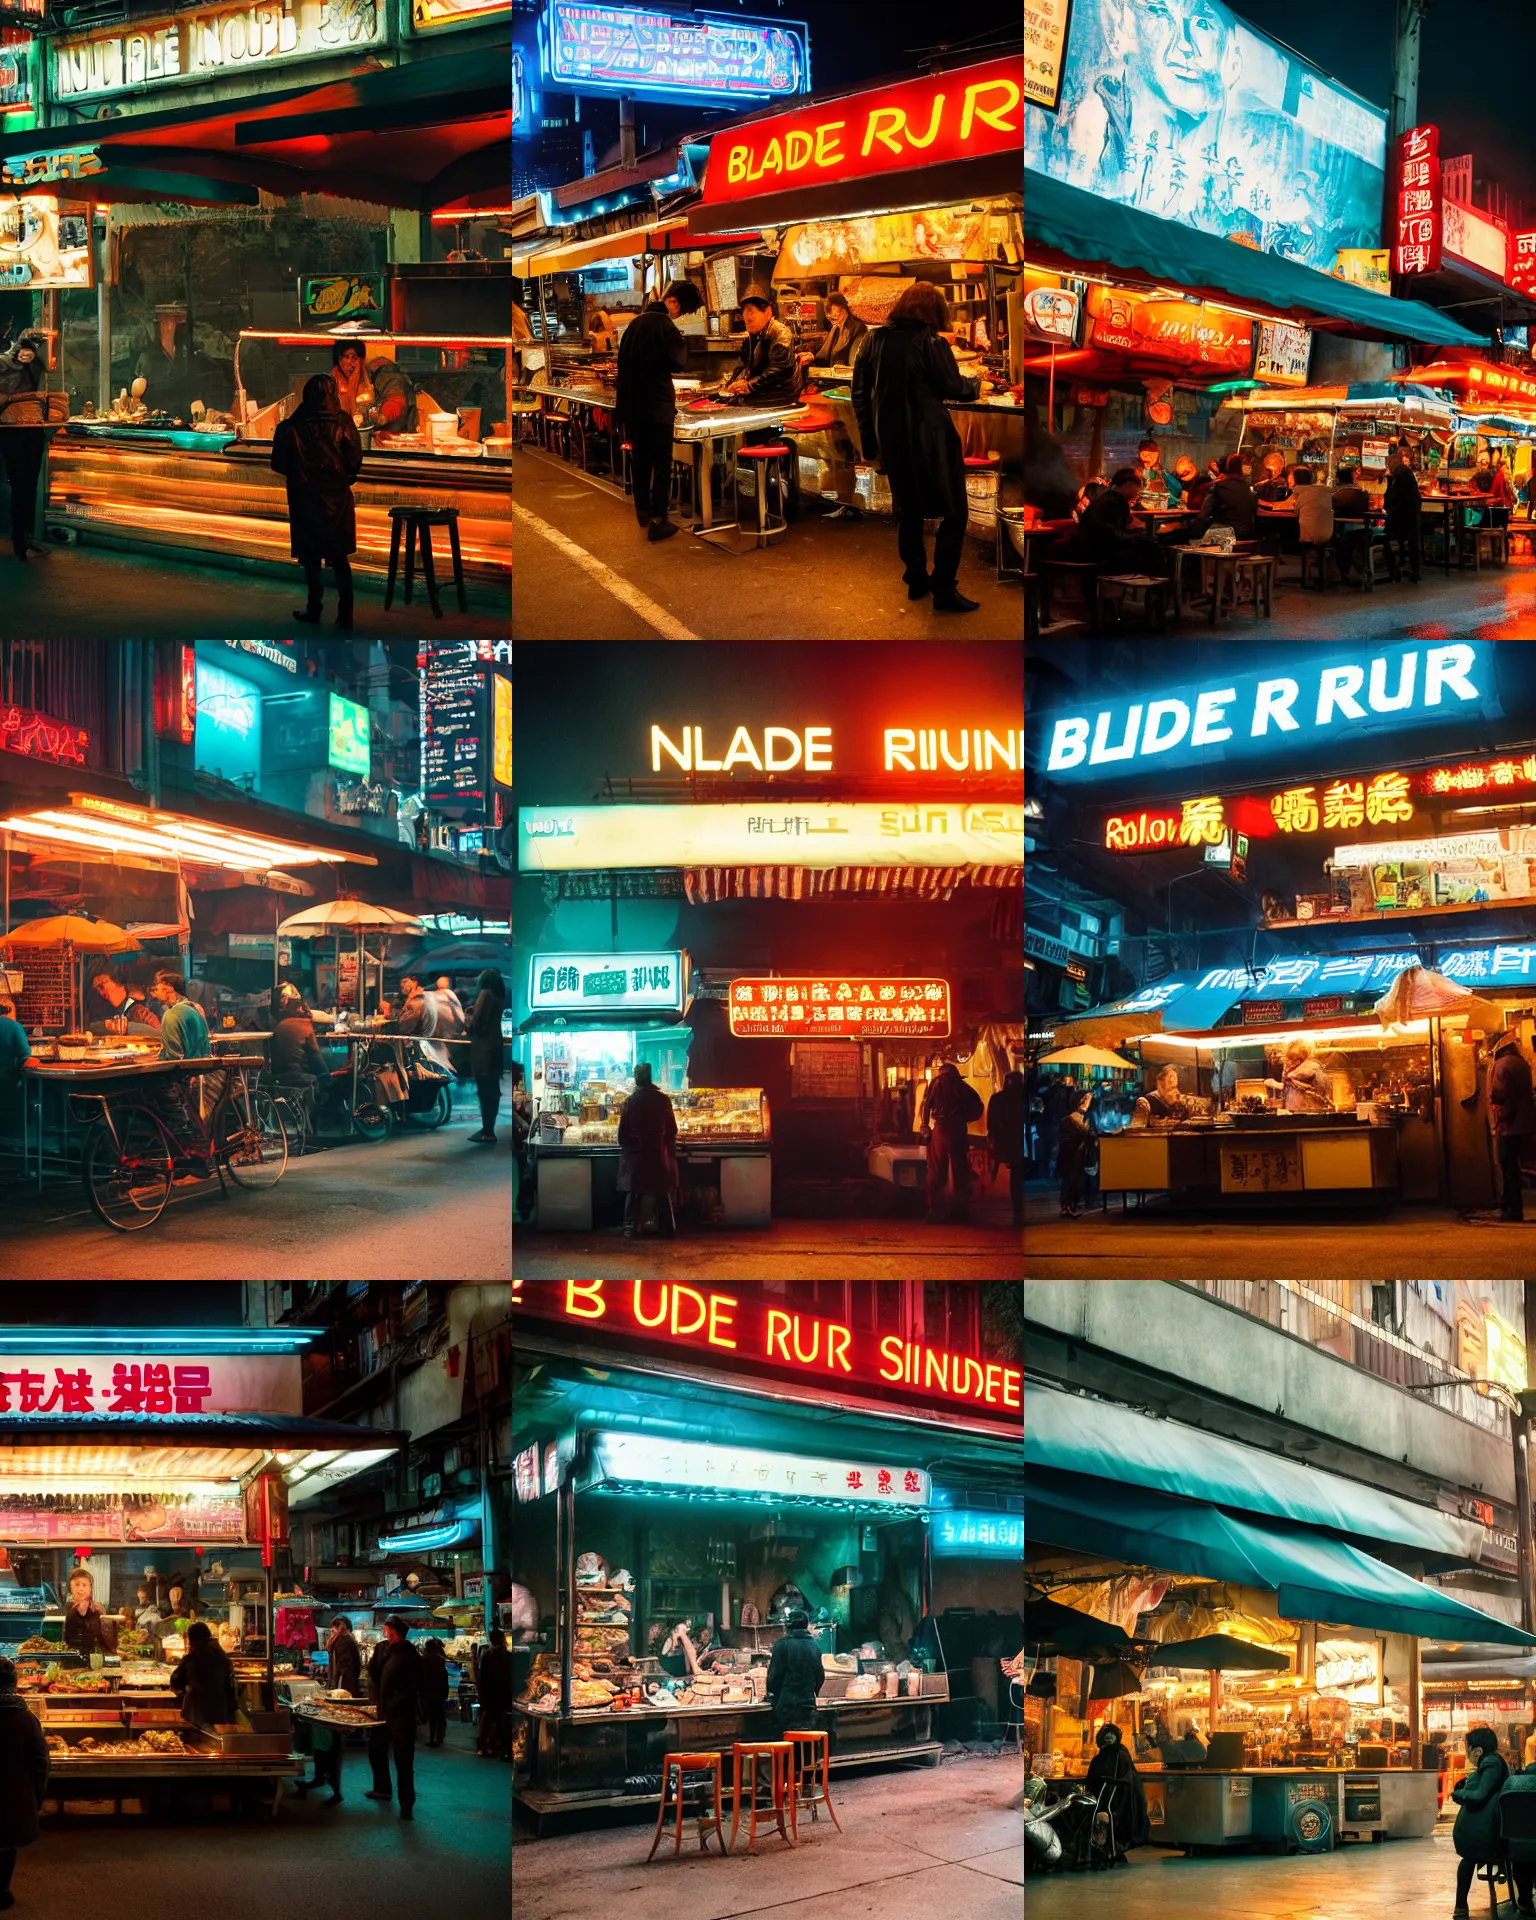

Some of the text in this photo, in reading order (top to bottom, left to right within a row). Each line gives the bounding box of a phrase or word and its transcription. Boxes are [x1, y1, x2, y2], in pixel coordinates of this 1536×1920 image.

[728, 121, 845, 183] BLADE
[651, 724, 833, 772] NLADE
[766, 1310, 852, 1372] RUR
